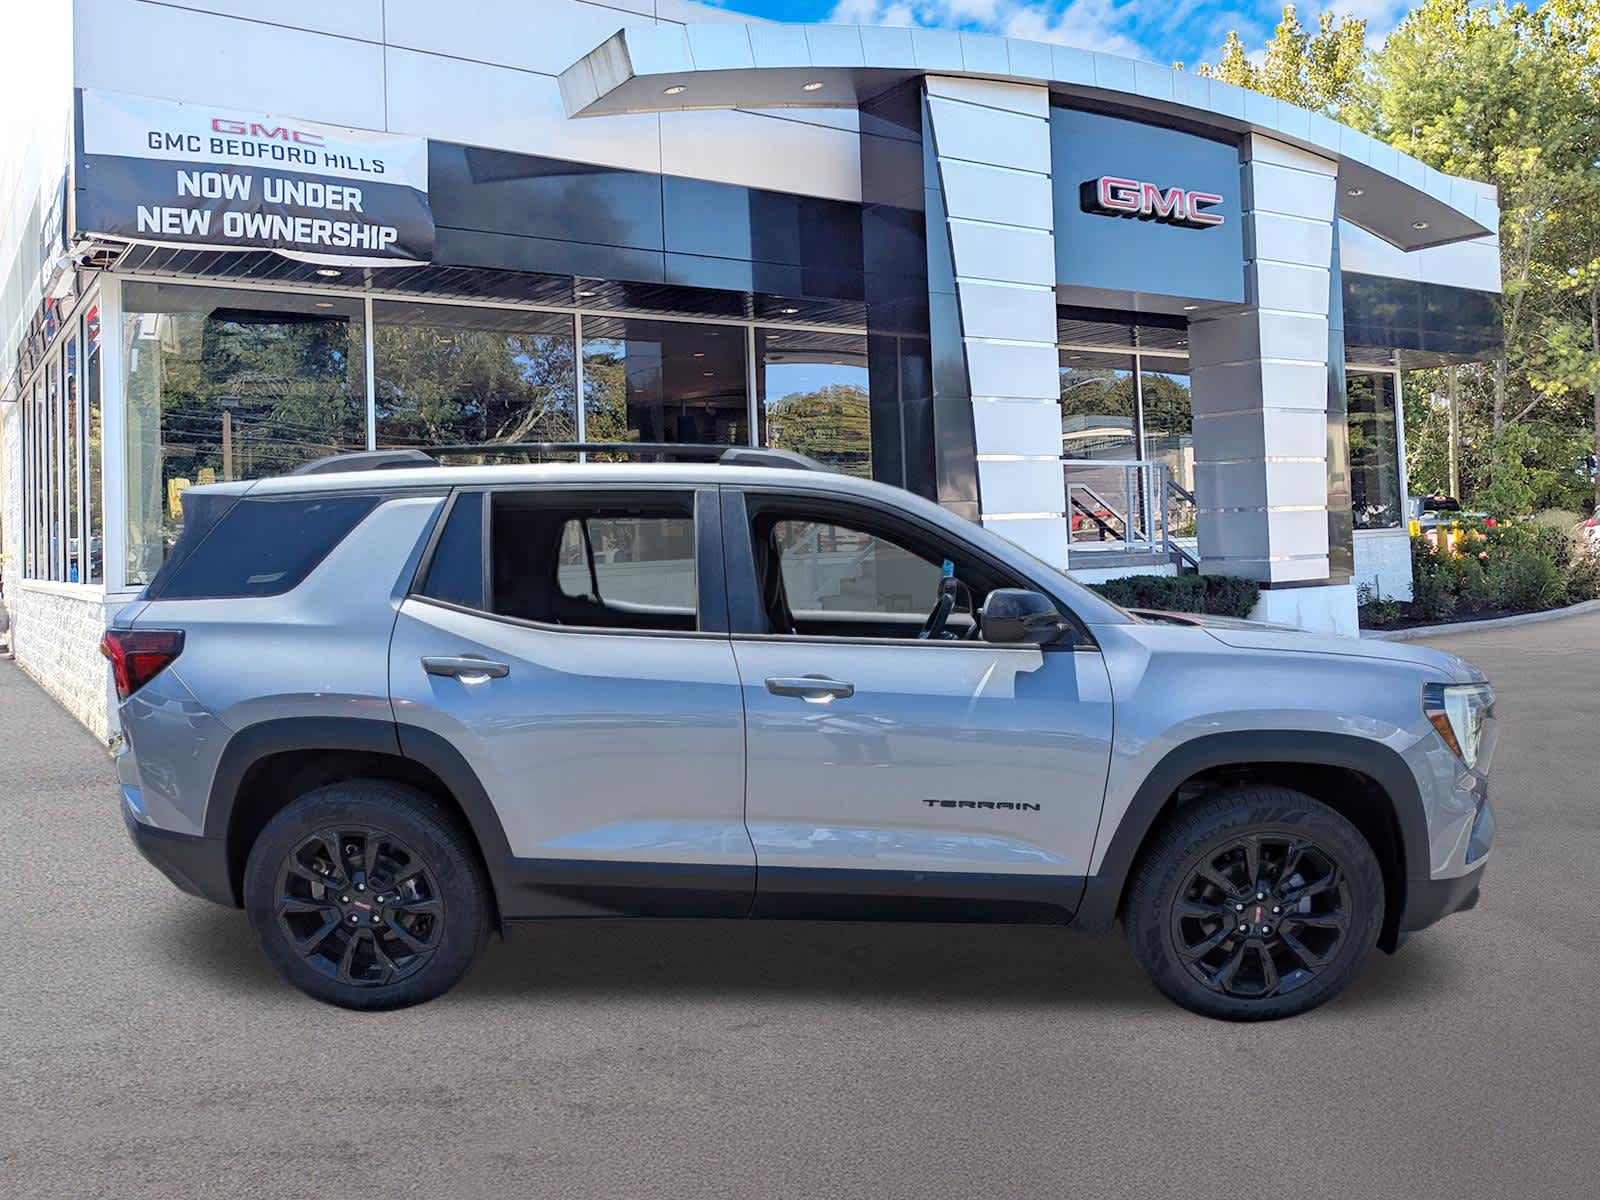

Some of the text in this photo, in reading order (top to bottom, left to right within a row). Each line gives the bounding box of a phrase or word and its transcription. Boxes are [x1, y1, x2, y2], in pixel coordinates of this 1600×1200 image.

[147, 131, 385, 174] GMC BEDFORD HILLS
[210, 118, 326, 148] GMC
[177, 170, 364, 213] NOW UNDER
[1096, 175, 1225, 225] GMC
[136, 205, 398, 251] NEW OWNERSHIP
[922, 799, 1041, 811] TERRAIN
